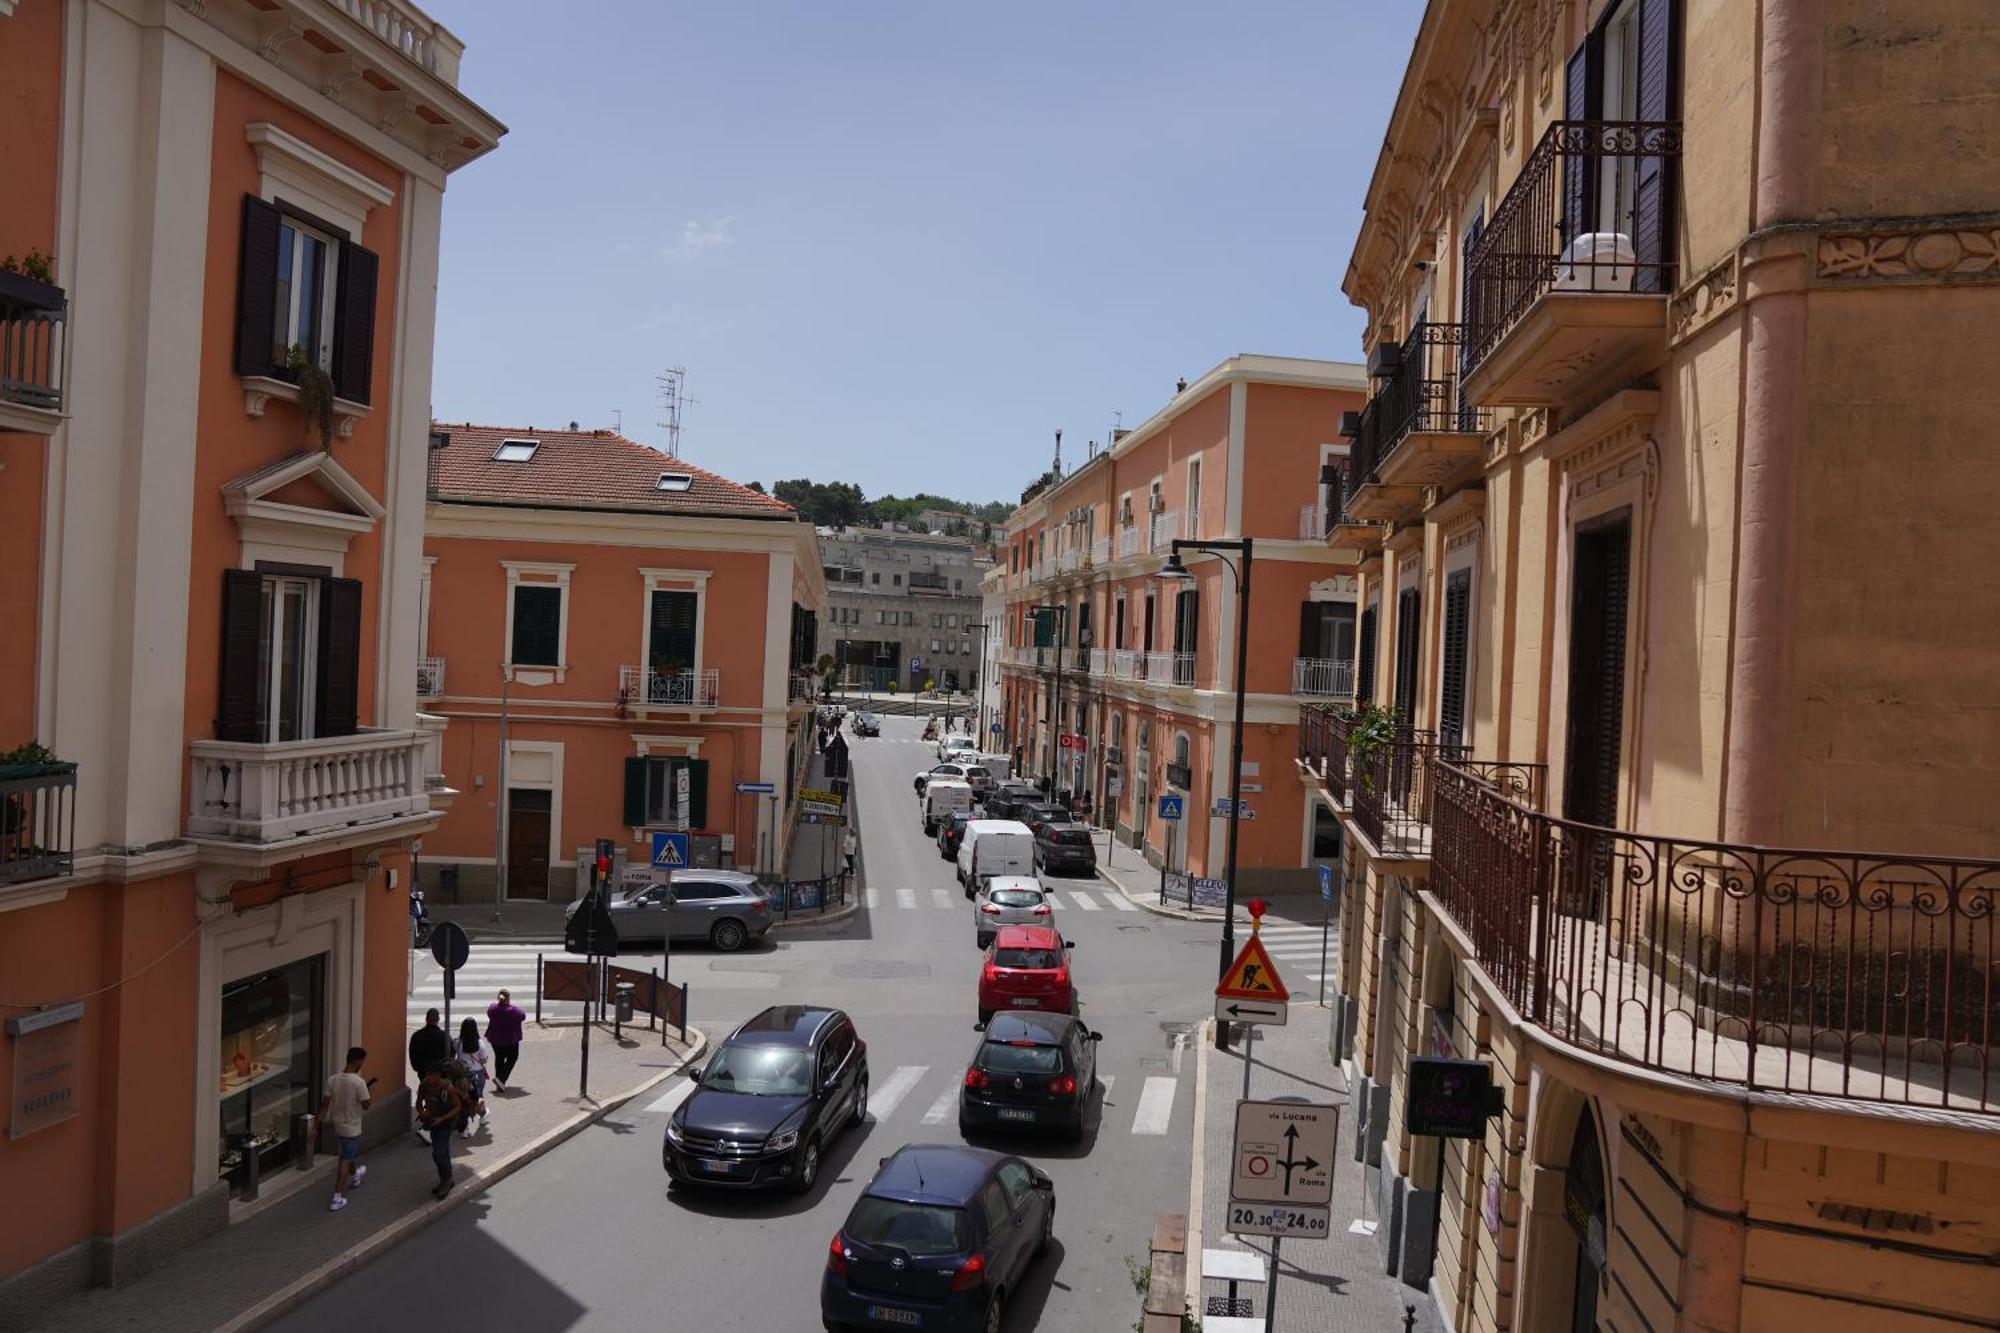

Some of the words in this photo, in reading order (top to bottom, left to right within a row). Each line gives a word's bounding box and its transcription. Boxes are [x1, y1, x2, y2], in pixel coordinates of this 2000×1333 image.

[912, 659, 919, 668] P
[1282, 1111, 1317, 1122] Lucana
[1299, 1177, 1326, 1187] Roma
[1234, 1208, 1273, 1226] 20.30
[1287, 1212, 1325, 1230] 24.00
